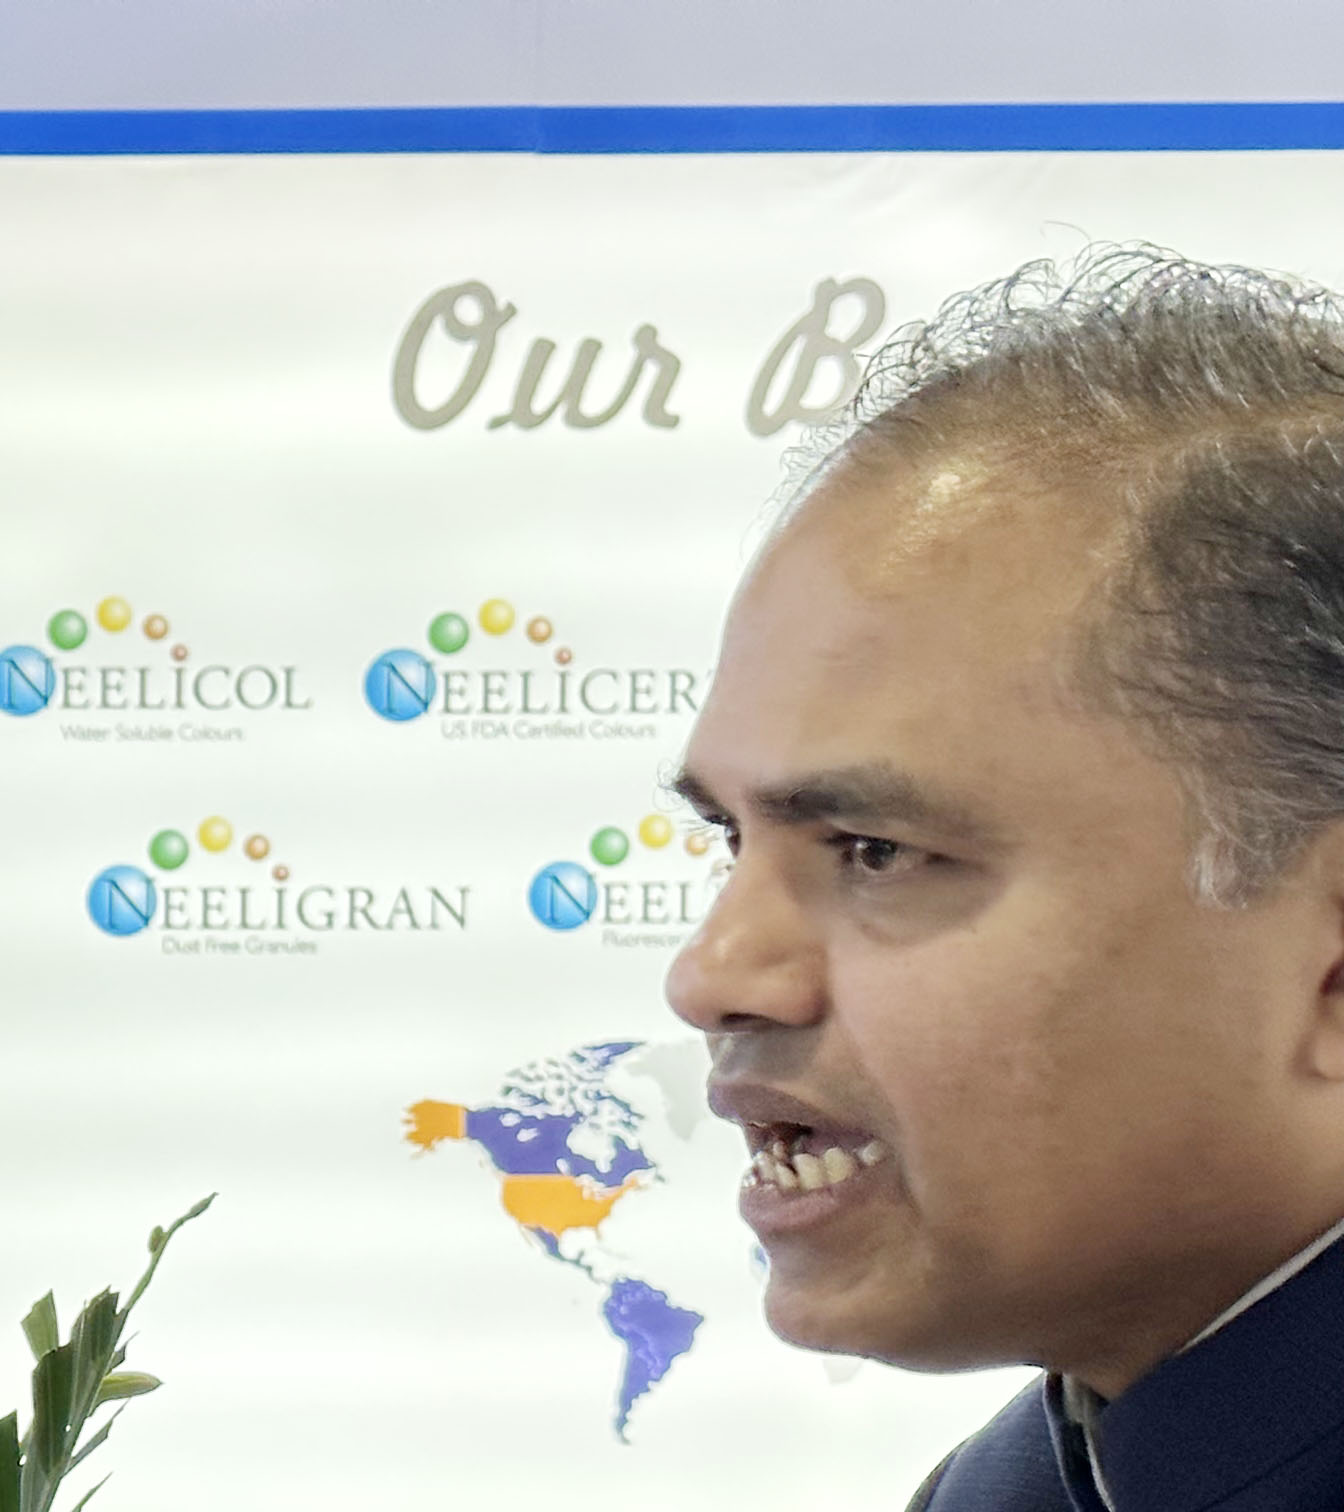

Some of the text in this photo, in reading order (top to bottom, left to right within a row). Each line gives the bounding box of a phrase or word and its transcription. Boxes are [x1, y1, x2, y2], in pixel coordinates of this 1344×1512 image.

[393, 280, 681, 432] Our
[381, 657, 714, 715] NEELICER
[60, 723, 244, 741] Water Soluble Colours
[471, 720, 509, 739] FDA
[513, 719, 584, 740] Certified
[588, 720, 658, 740] Colours
[545, 871, 720, 925] NEEL
[162, 936, 318, 955] Dust Free Granules
